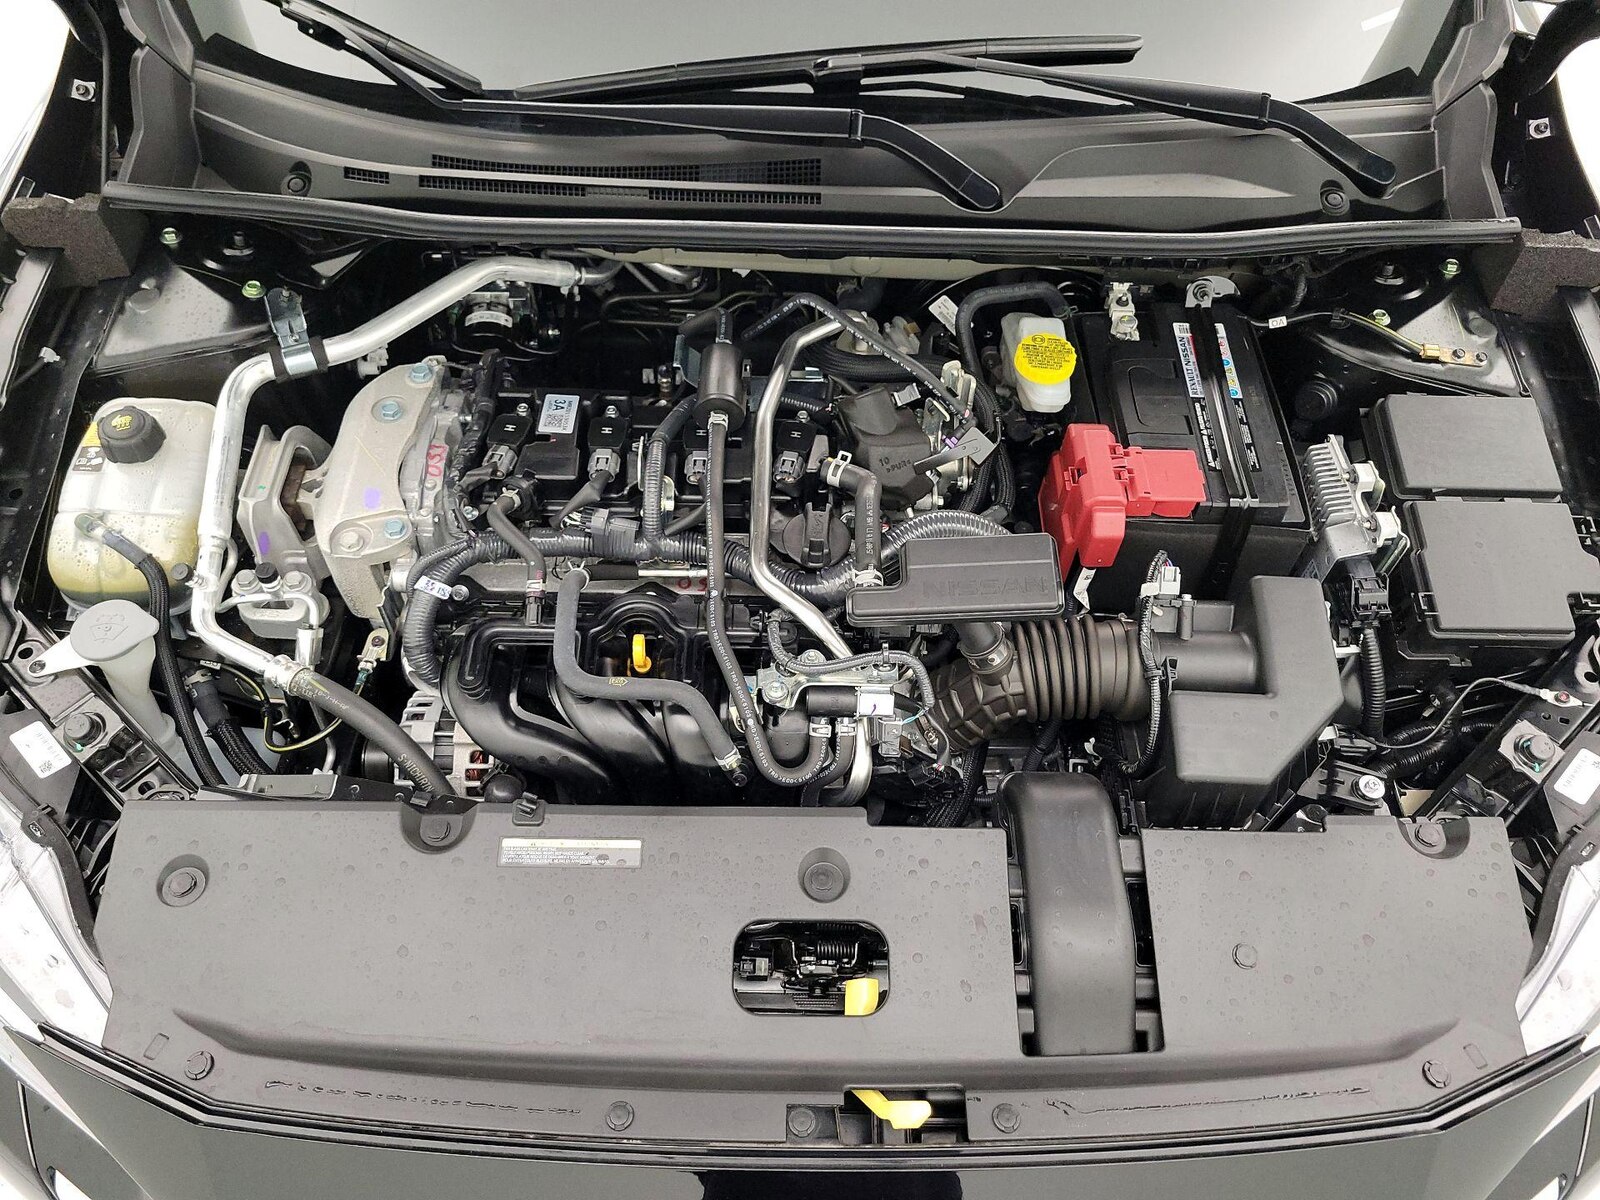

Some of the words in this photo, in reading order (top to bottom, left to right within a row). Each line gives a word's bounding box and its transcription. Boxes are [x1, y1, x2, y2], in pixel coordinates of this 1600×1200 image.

[1178, 337, 1192, 367] NISSAN
[1186, 368, 1199, 396] RENAULT
[552, 399, 566, 411] 3A
[879, 456, 890, 467] 10
[921, 575, 1049, 599] NISSAN
